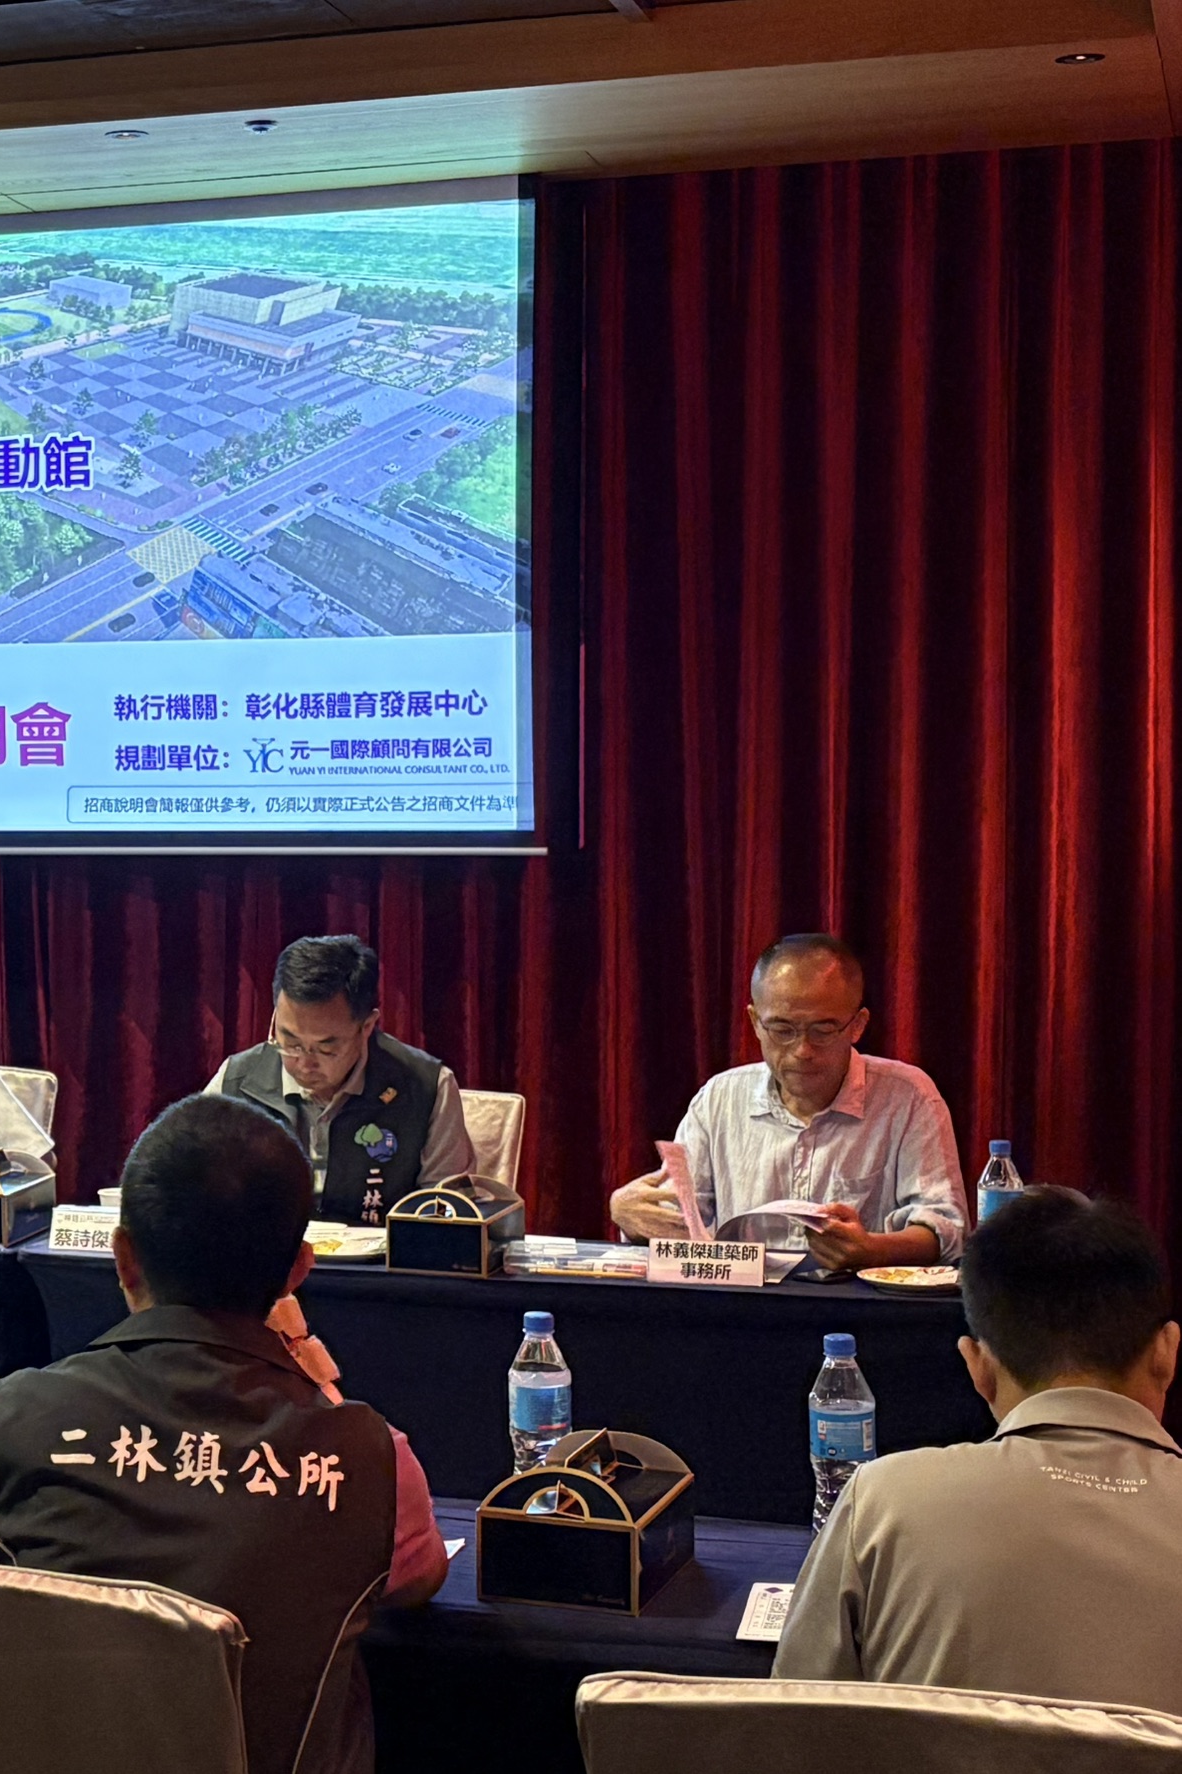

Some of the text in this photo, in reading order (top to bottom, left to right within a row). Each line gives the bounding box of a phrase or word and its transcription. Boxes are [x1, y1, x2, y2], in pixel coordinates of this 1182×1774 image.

[290, 737, 493, 760] 元一國際顧問有限公司
[289, 766, 315, 775] YUAN
[317, 766, 326, 775] YI
[328, 765, 403, 775] INTERNATIONAL
[404, 764, 467, 774] CONSULTANT
[490, 764, 510, 773] LTD.
[656, 1241, 759, 1262] 林義傑建築師
[680, 1262, 732, 1280] 事務所
[50, 1424, 345, 1512] 二林鎮公所
[1050, 1474, 1139, 1493] SPORTS CENTER
[1074, 1472, 1100, 1482] CIVIL
[1115, 1478, 1148, 1486] CHILD
